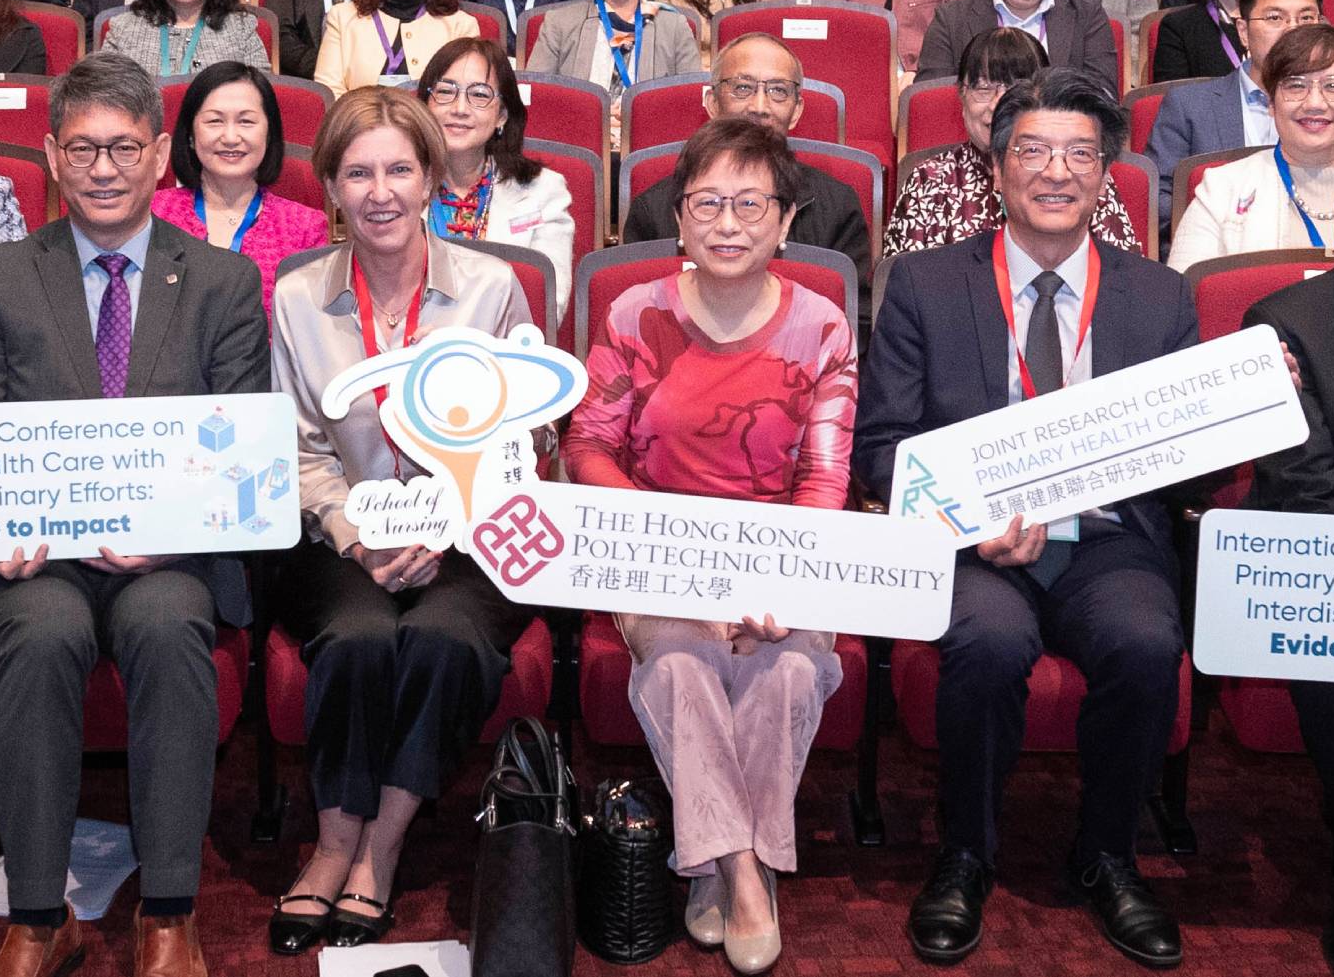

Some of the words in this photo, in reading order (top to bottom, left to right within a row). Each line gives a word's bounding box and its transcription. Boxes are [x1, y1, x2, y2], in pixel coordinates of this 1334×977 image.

[971, 432, 1026, 464] JOINT
[1034, 397, 1139, 442] RESEARCH
[1145, 369, 1225, 407] CENTRE
[1230, 354, 1274, 380] FOR
[154, 421, 183, 436] on
[976, 444, 1063, 486] PRIMARY
[1071, 418, 1151, 456] HEALTH
[1157, 399, 1211, 428] CARE
[43, 452, 104, 472] Care
[112, 448, 164, 469] with
[502, 438, 523, 484] 護理
[70, 482, 152, 502] Efforts:
[357, 492, 419, 513] School
[426, 487, 443, 514] of
[987, 446, 1185, 521] 基層健康聯合研究中心
[7, 520, 33, 537] to
[40, 515, 130, 540] Impact
[371, 516, 450, 537] Nursing
[575, 505, 634, 532] THE
[643, 513, 728, 541] HONG
[737, 522, 816, 549] KONG
[573, 535, 770, 574] POLYTECHNIC
[779, 554, 944, 590] UNIVERSITY
[569, 564, 731, 600] 香港理工大學
